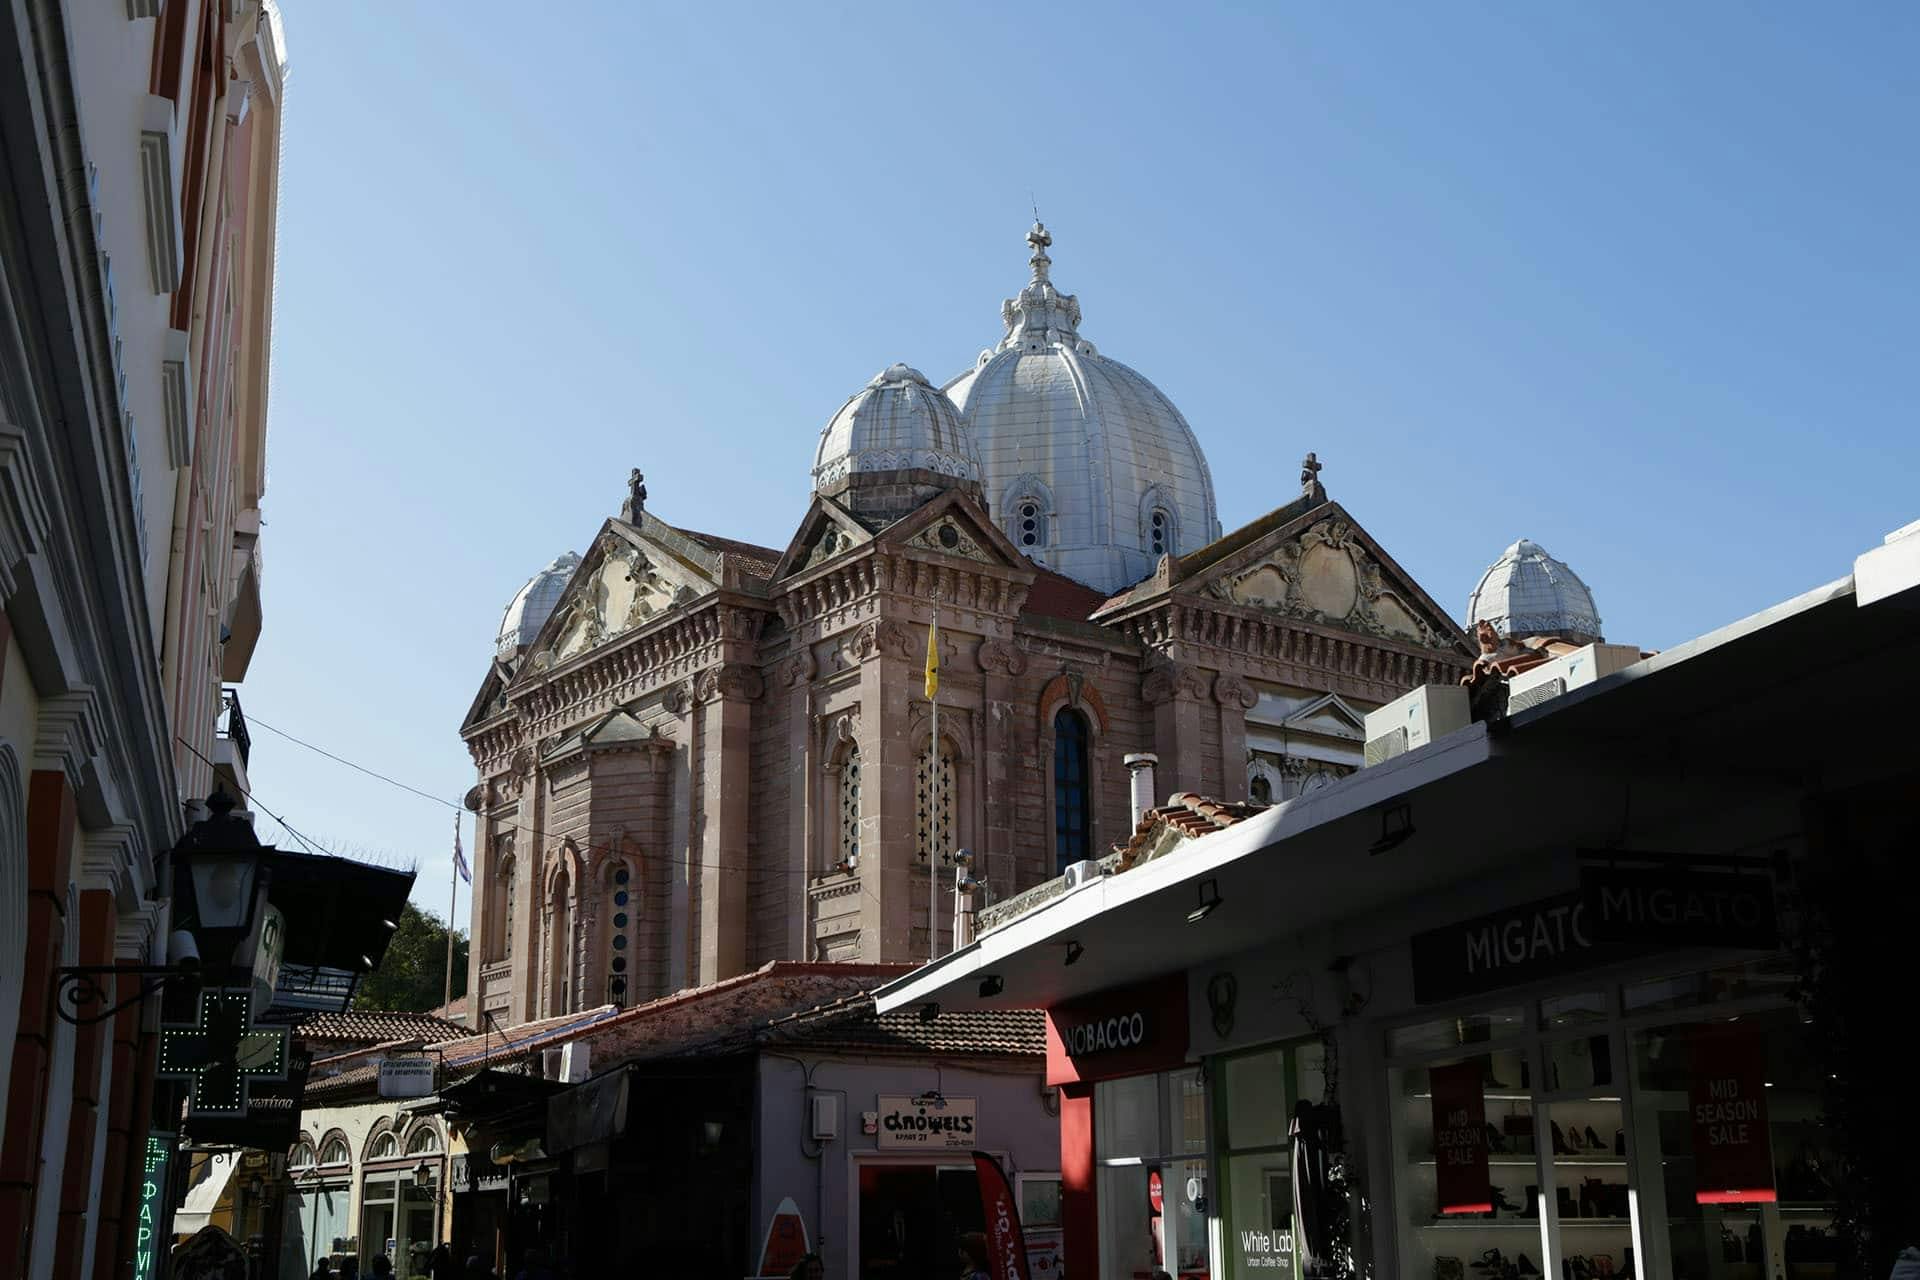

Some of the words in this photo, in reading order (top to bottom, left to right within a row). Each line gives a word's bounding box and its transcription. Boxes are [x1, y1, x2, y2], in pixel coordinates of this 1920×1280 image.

[1600, 887, 1761, 927] MIGATO
[1709, 1079, 1739, 1098] MID
[1695, 1100, 1758, 1123] SEASON
[1439, 1127, 1480, 1146] SEASON
[1709, 1124, 1749, 1145] SALE
[1447, 1146, 1473, 1165] SALE
[1241, 1230, 1270, 1253] White
[1272, 1229, 1293, 1253] Lab
